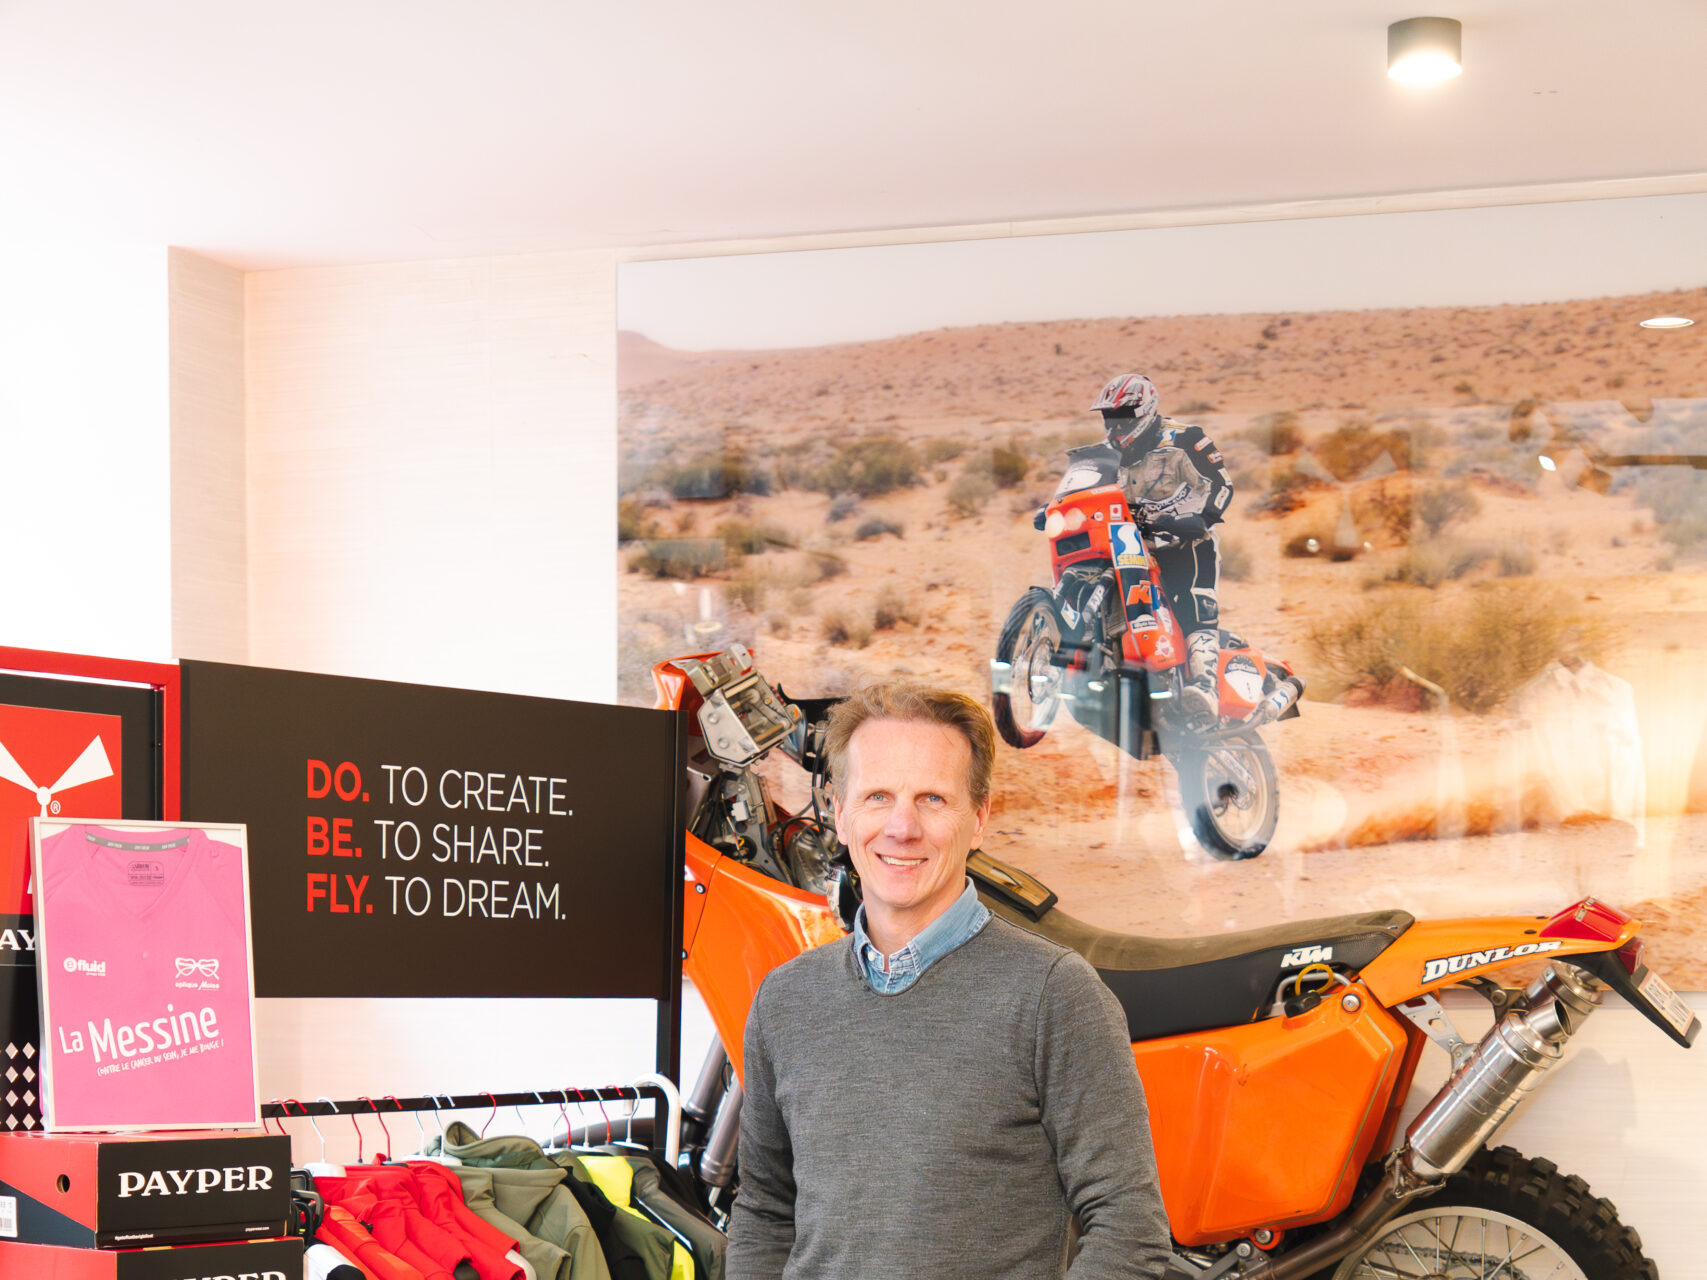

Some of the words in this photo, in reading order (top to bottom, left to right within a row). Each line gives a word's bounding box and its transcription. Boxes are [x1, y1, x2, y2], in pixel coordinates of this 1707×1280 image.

[307, 759, 370, 802] DO.
[381, 764, 428, 806] TO
[439, 769, 573, 816] CREATE.
[307, 816, 362, 858] BE.
[374, 819, 421, 861] TO
[432, 823, 549, 867] SHARE.
[307, 872, 373, 914] FLY.
[385, 876, 431, 916] TO
[443, 878, 566, 920] DREAM.
[1280, 944, 1333, 968] KTM
[1422, 941, 1563, 985] DUNLOP
[58, 1026, 85, 1054] La
[87, 1003, 220, 1064] Messine
[117, 1165, 273, 1198] PAYPER
